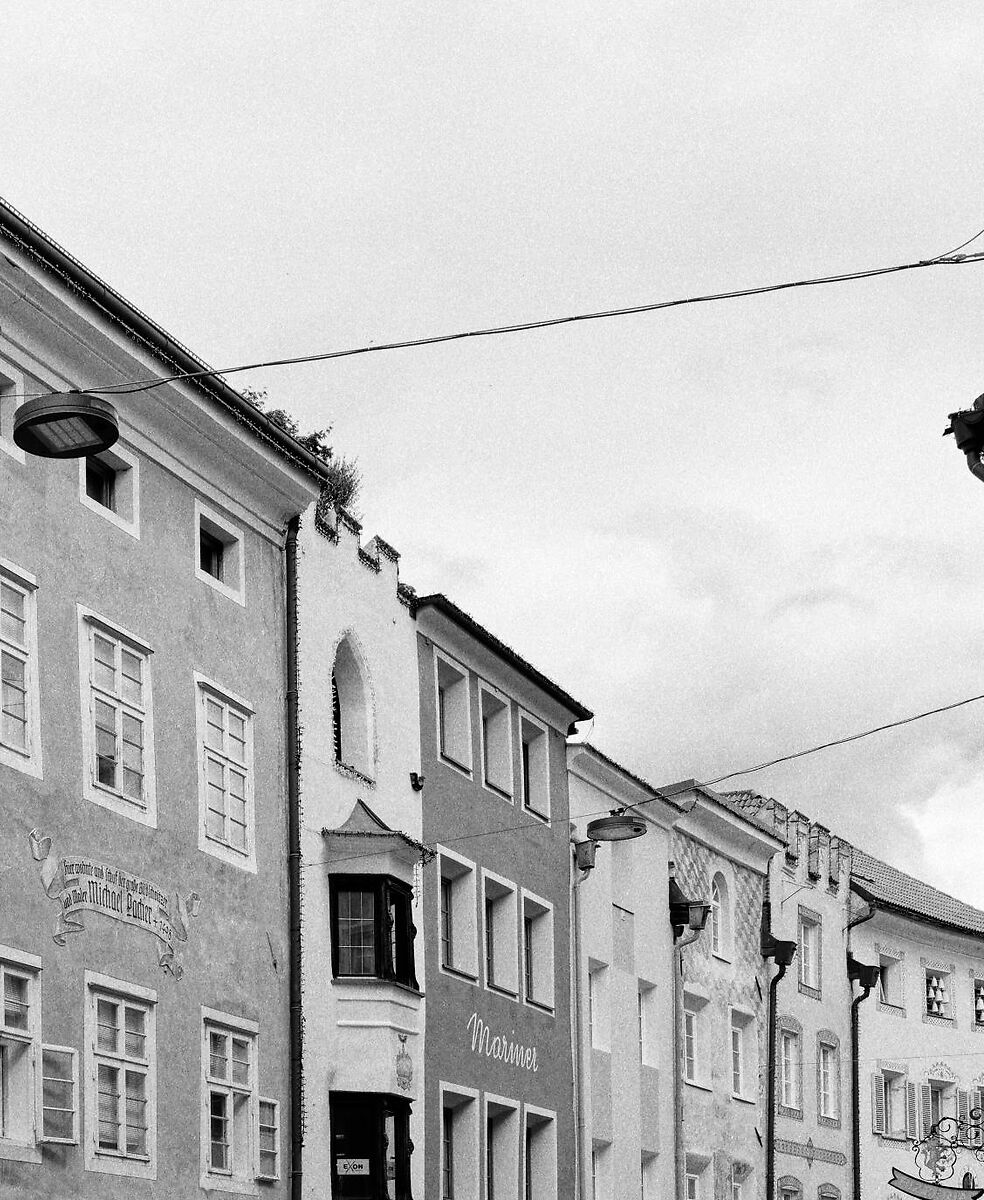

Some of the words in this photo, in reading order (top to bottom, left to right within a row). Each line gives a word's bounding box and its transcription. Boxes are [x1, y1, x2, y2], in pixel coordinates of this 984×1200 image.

[88, 880, 123, 914] Michael
[127, 892, 152, 925] Pacher
[467, 1012, 539, 1072] Mariner
